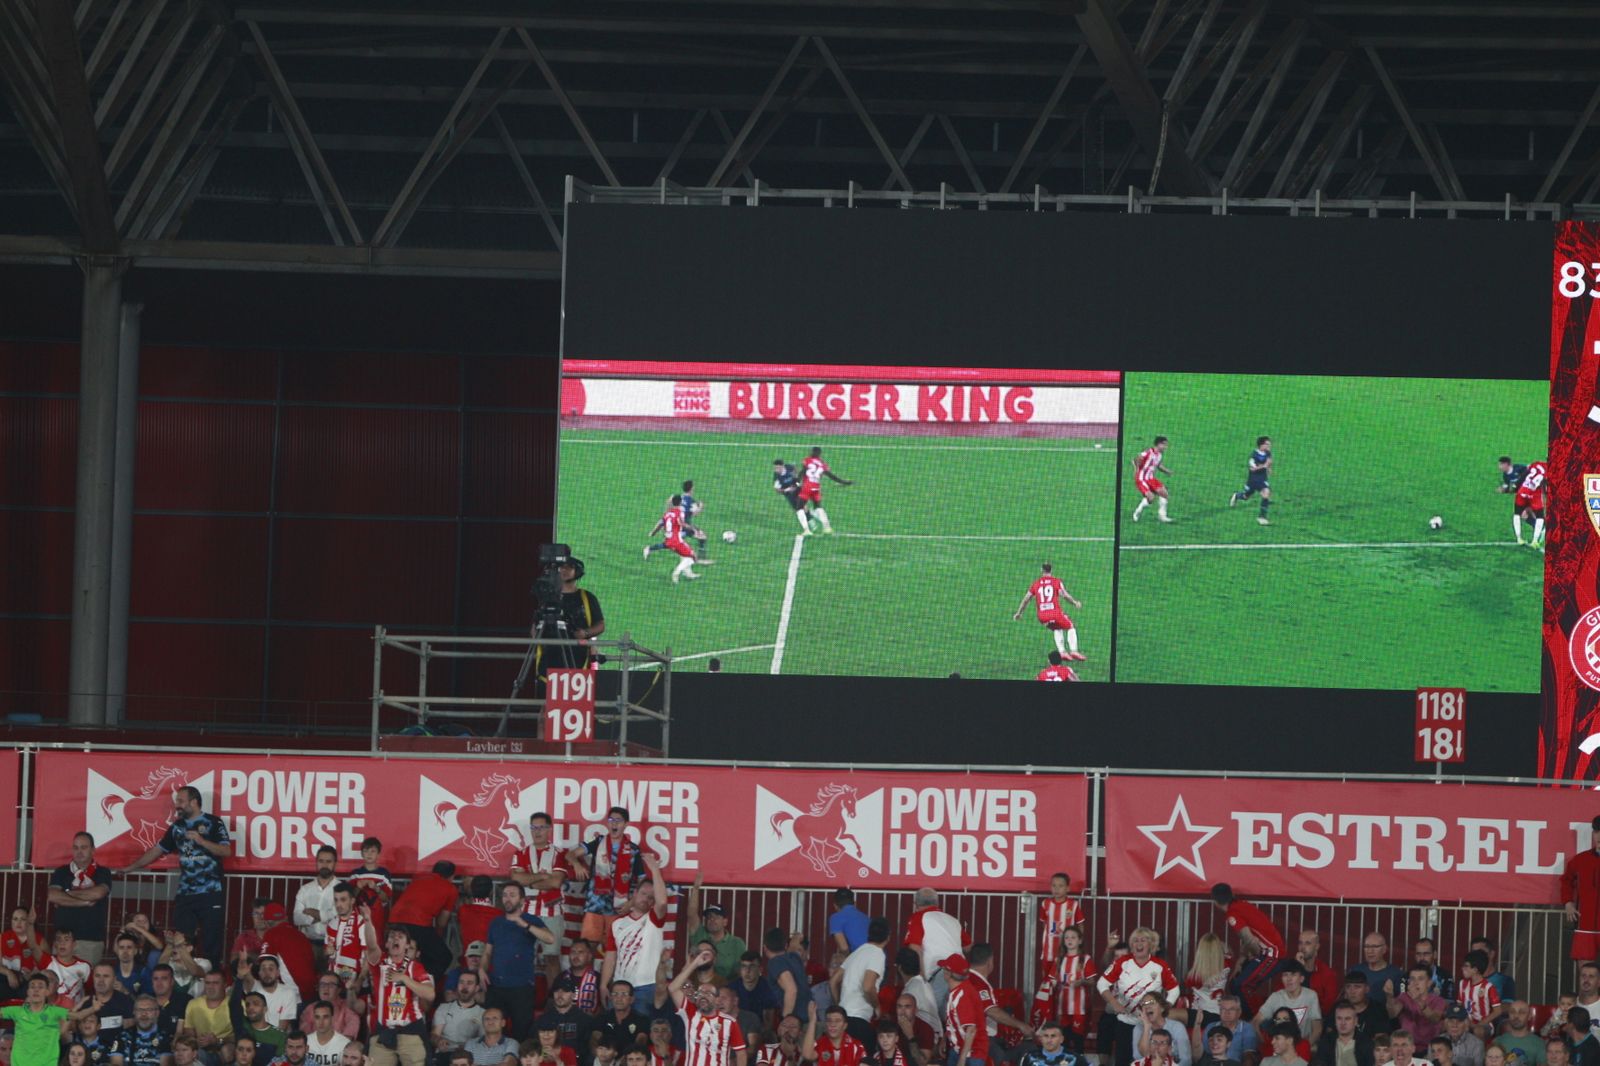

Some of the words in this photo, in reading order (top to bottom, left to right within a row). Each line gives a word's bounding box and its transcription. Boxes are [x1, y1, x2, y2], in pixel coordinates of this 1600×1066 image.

[674, 398, 711, 411] KING
[729, 381, 900, 420] BURGER
[917, 384, 1034, 423] KING
[1037, 585, 1054, 603] 19
[548, 672, 587, 702] 119
[1418, 692, 1456, 720] 118
[547, 709, 584, 741] 19
[1418, 728, 1454, 760] 18
[221, 769, 365, 814] POWER
[553, 778, 699, 824] POWER
[890, 787, 1037, 831] POWER
[221, 816, 365, 860] HORSE
[889, 833, 1037, 877] HORSE
